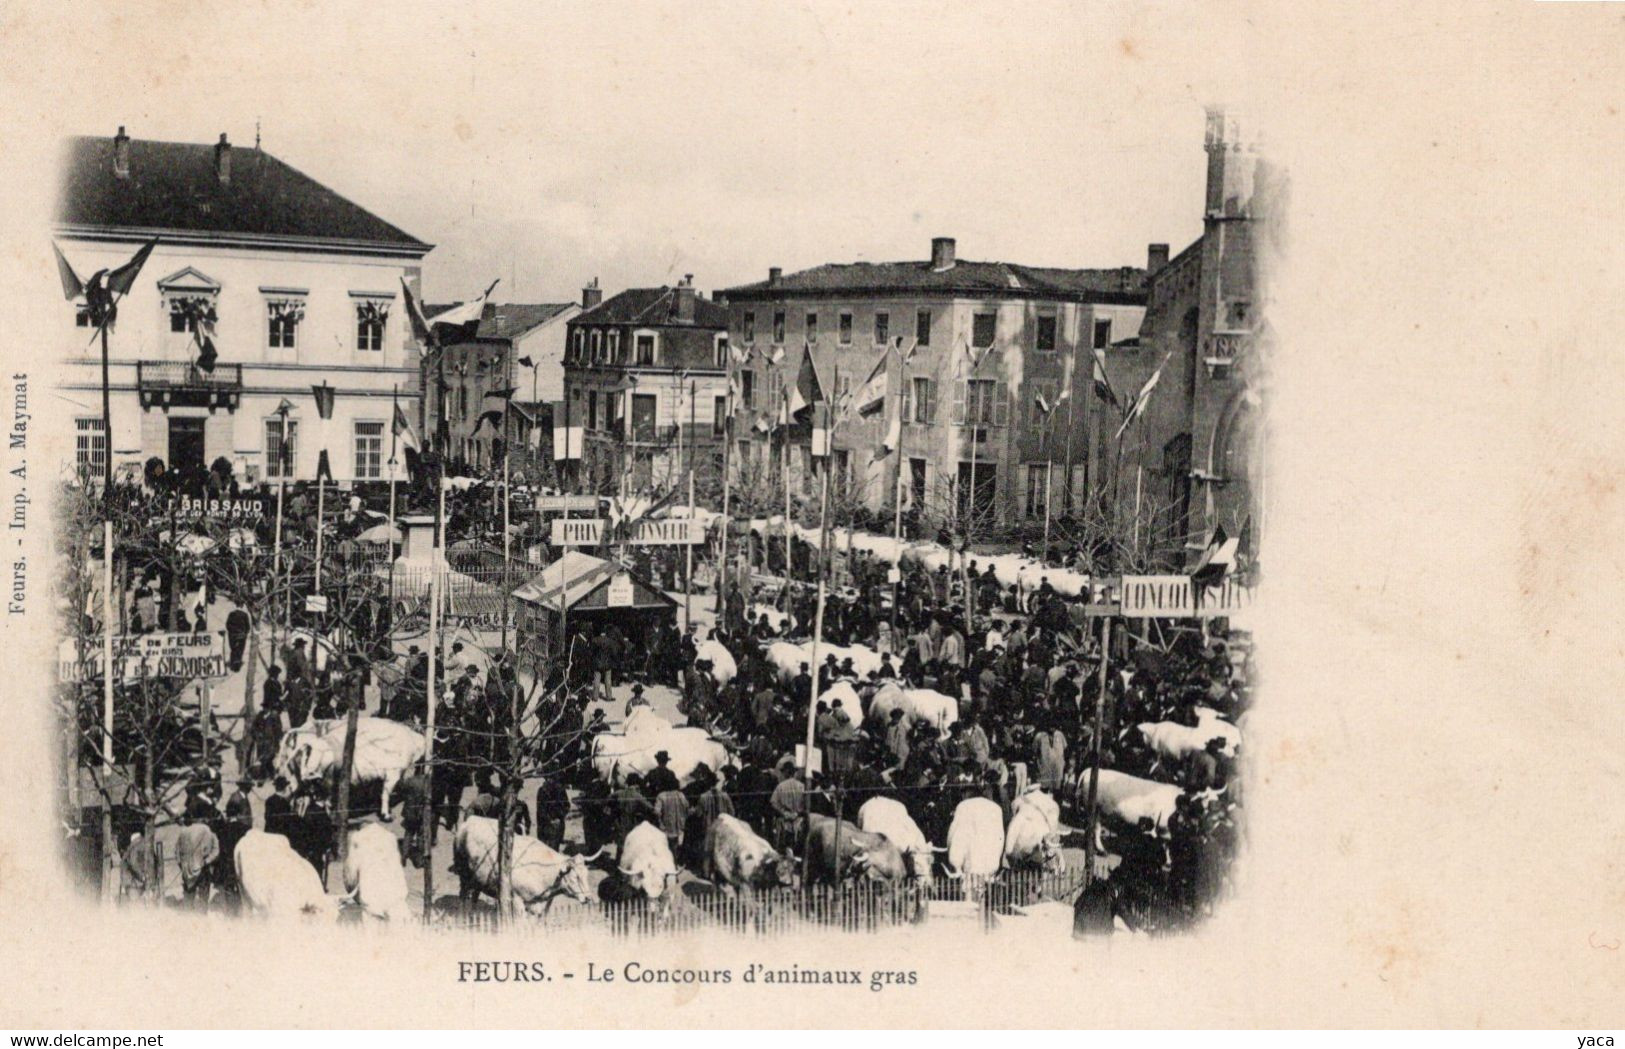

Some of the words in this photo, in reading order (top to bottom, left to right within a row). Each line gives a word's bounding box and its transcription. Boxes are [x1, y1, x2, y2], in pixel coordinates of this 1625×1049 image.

[9, 373, 31, 449] Maymat
[9, 459, 27, 479] A.
[8, 487, 30, 530] Imp.
[181, 499, 263, 511] BRISSAUD
[563, 523, 598, 541] PRIX
[8, 556, 26, 615] Feurs.
[167, 635, 212, 647] FEURS
[457, 960, 553, 983] FEURS.
[587, 962, 614, 983] Le
[623, 961, 732, 984] Concours
[870, 970, 918, 992] gras
